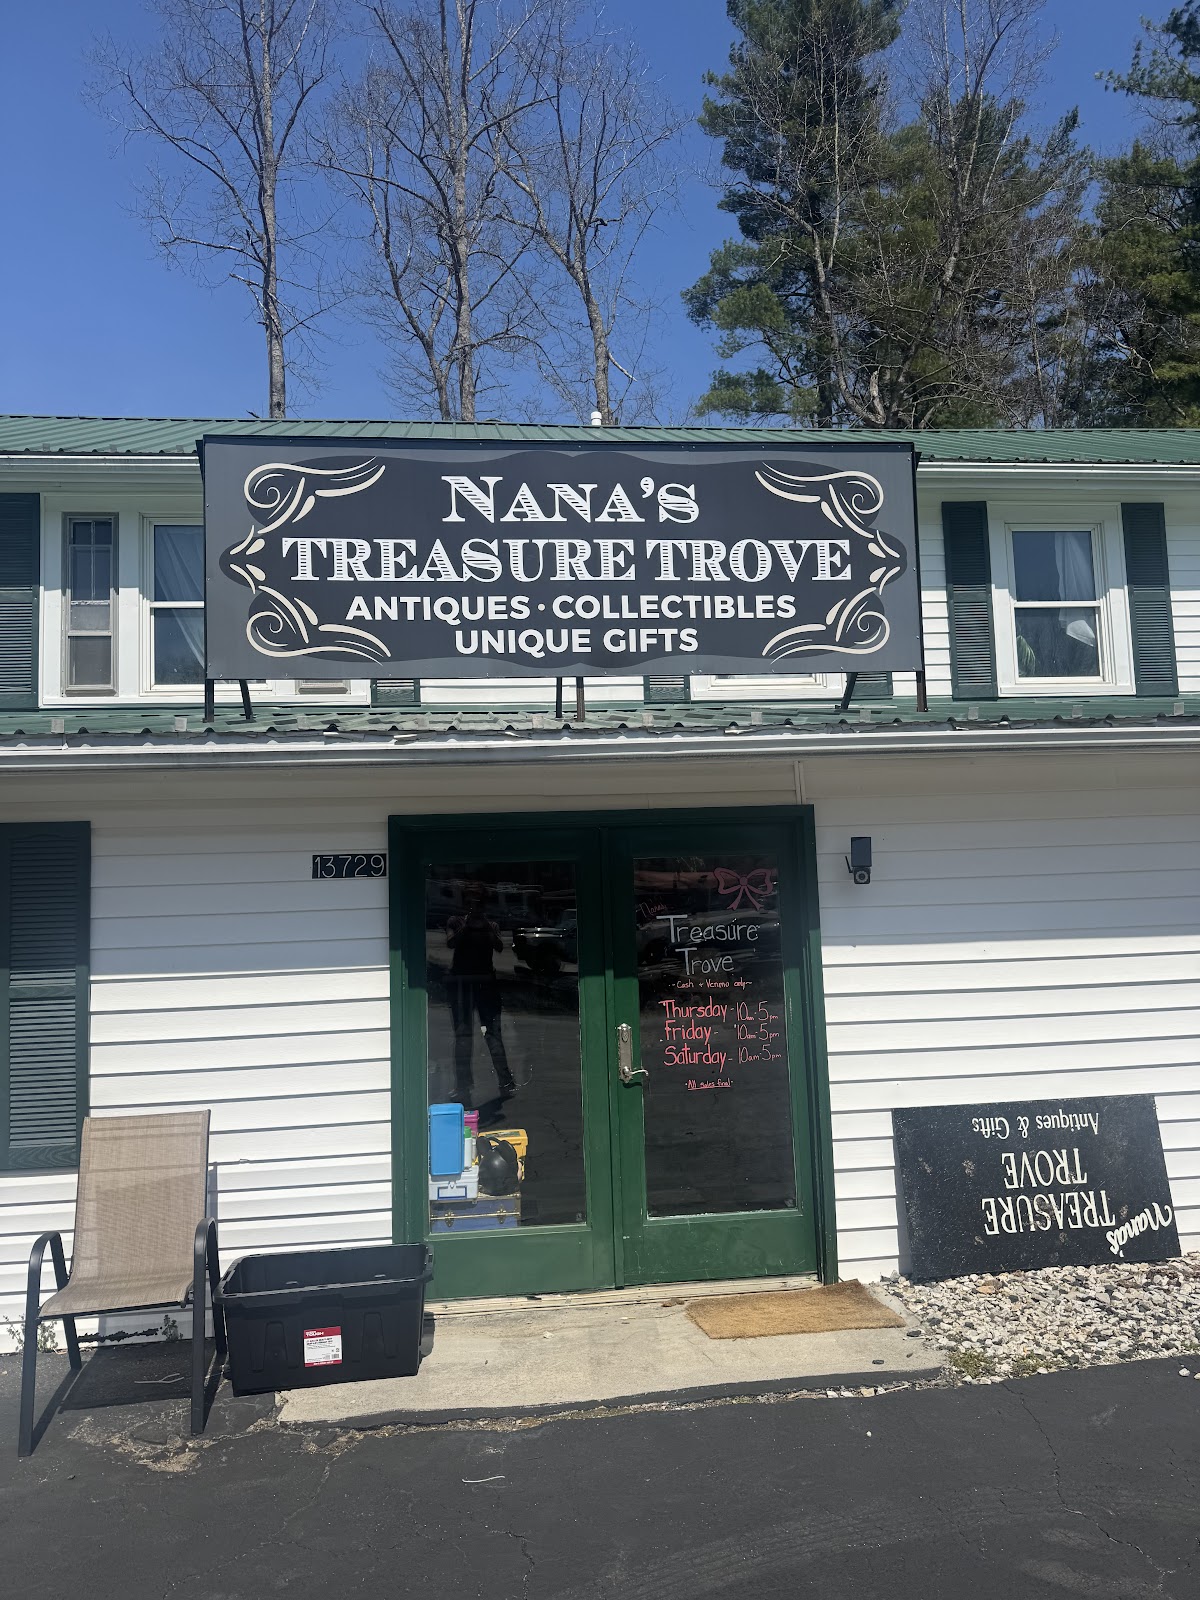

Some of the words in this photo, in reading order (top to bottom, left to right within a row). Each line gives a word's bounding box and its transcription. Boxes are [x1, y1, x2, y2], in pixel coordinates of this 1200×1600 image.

[441, 475, 700, 524] NANA'S
[282, 537, 636, 583] TREASURE
[646, 537, 852, 582] TROVE
[345, 595, 531, 626] ANTIQUES
[552, 594, 797, 620] COLLECTIBLES
[455, 628, 592, 659] UNIQUE
[603, 627, 699, 653] GIFTS
[314, 854, 385, 879] 13729
[656, 914, 759, 943] Treasure
[675, 948, 735, 976] Trove
[705, 979, 730, 989] Venmo
[972, 1116, 1010, 1140] Gifts
[1017, 1116, 1030, 1138] &
[1037, 1109, 1100, 1135] Antiques
[1001, 1147, 1088, 1190] TROVE
[981, 1190, 1116, 1236] TREASURE
[1105, 1202, 1173, 1258] Nana's
